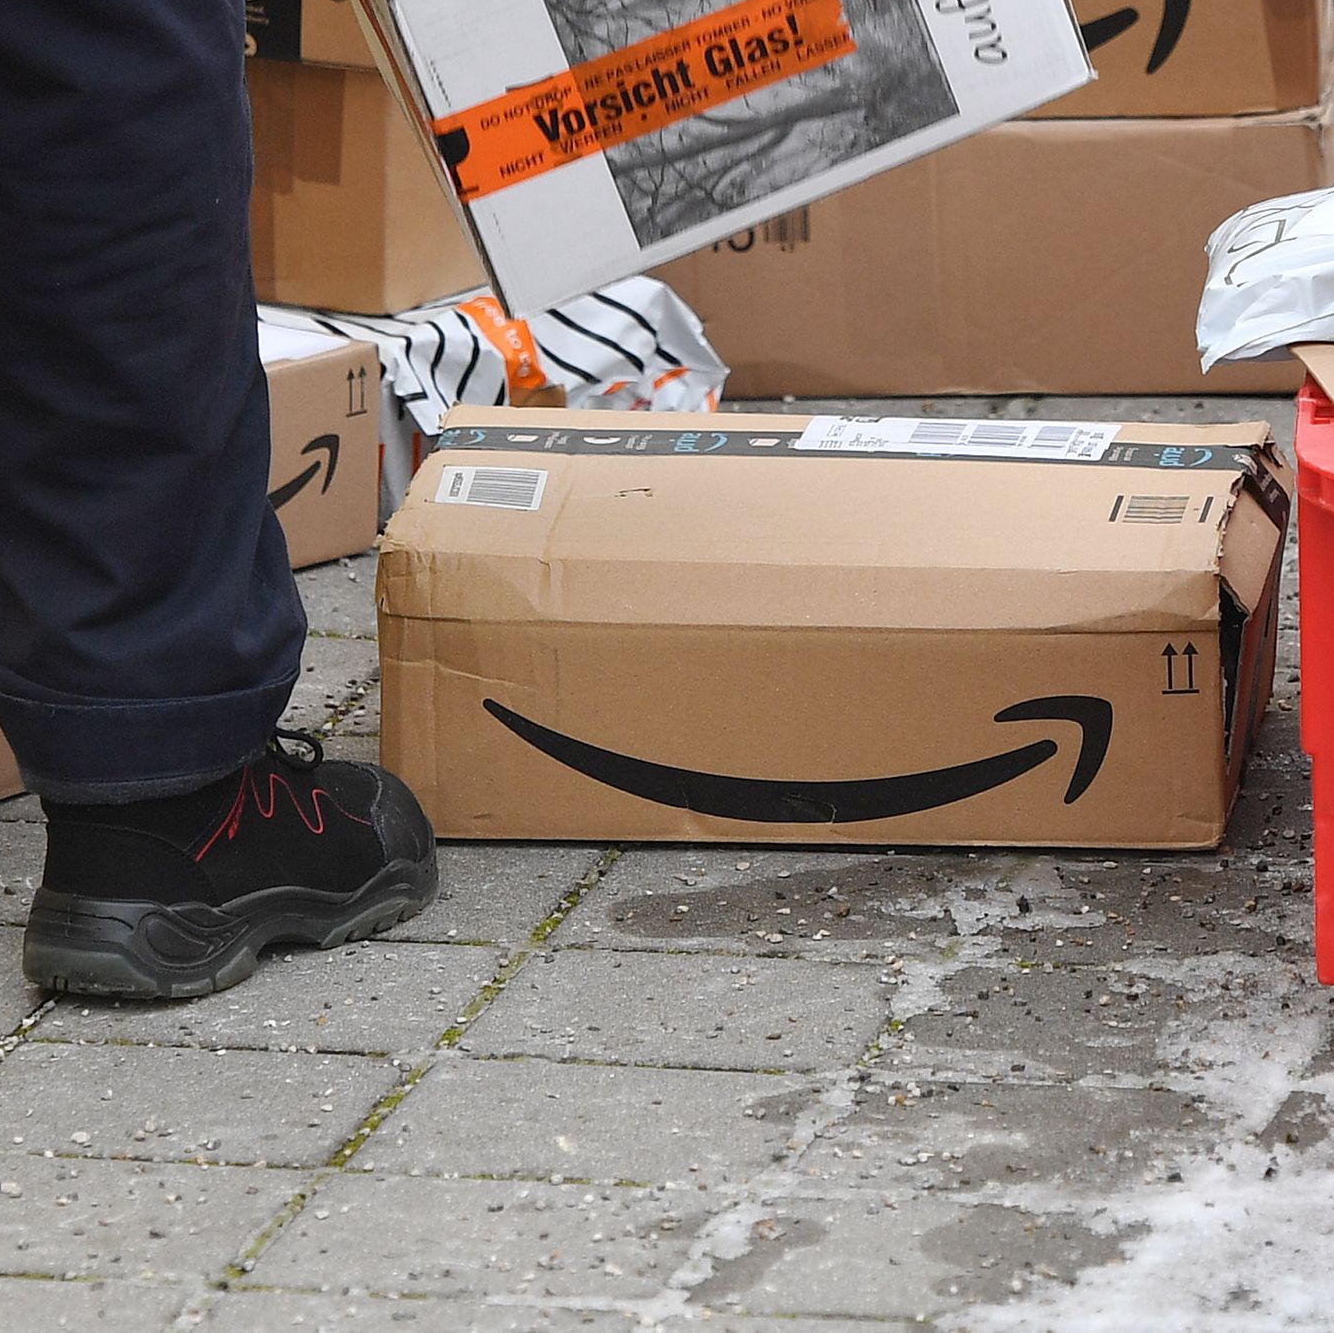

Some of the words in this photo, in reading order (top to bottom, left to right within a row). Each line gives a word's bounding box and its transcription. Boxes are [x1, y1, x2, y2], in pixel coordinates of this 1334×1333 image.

[480, 114, 500, 131] DO
[503, 103, 531, 122] NOT
[535, 86, 573, 109] DROP
[636, 39, 692, 70] LAISSER
[696, 18, 751, 46] TOMBER
[762, 2, 783, 20] NO
[499, 153, 545, 178] NICHT
[560, 122, 624, 154] WERFEN
[664, 86, 709, 115] NICHT
[725, 59, 782, 90] FALLEN
[533, 57, 695, 143] Vorsicht
[704, 13, 804, 78] Glas!
